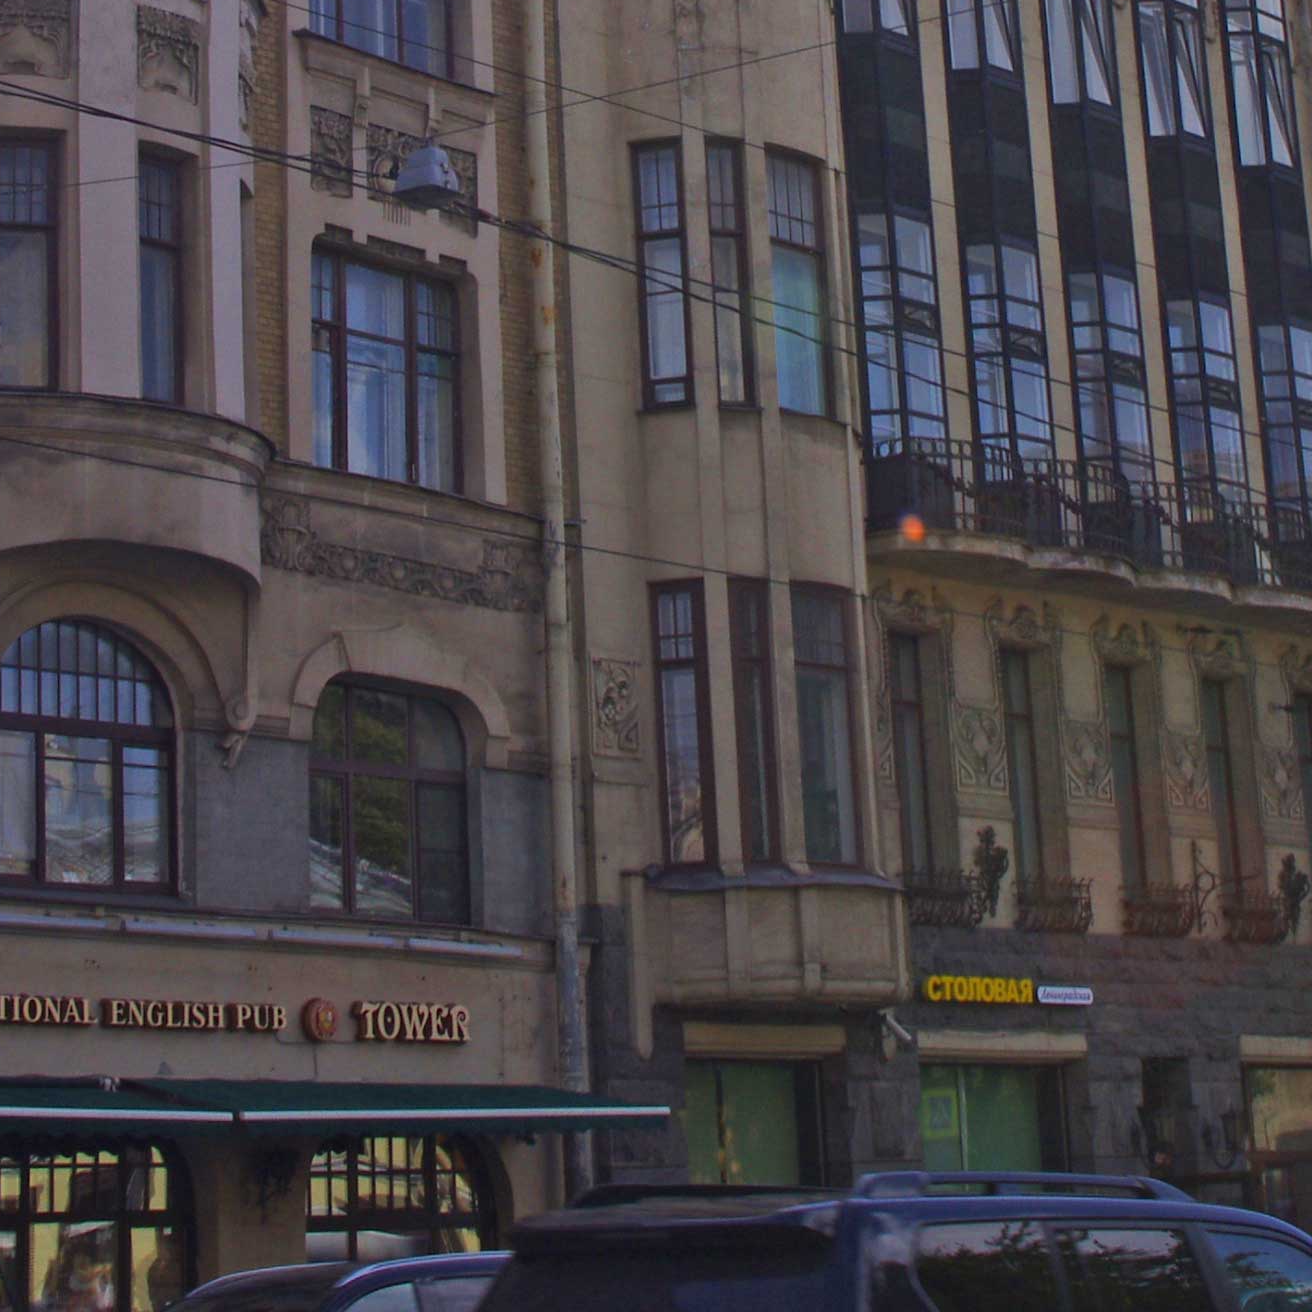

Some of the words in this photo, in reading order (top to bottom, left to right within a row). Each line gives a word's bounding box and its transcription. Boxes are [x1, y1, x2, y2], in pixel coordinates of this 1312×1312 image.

[926, 974, 1034, 1004] СТОЛОВАЯ
[110, 999, 226, 1029] ENGLISH
[237, 1004, 288, 1029] PUB
[360, 1001, 471, 1042] TOWER
